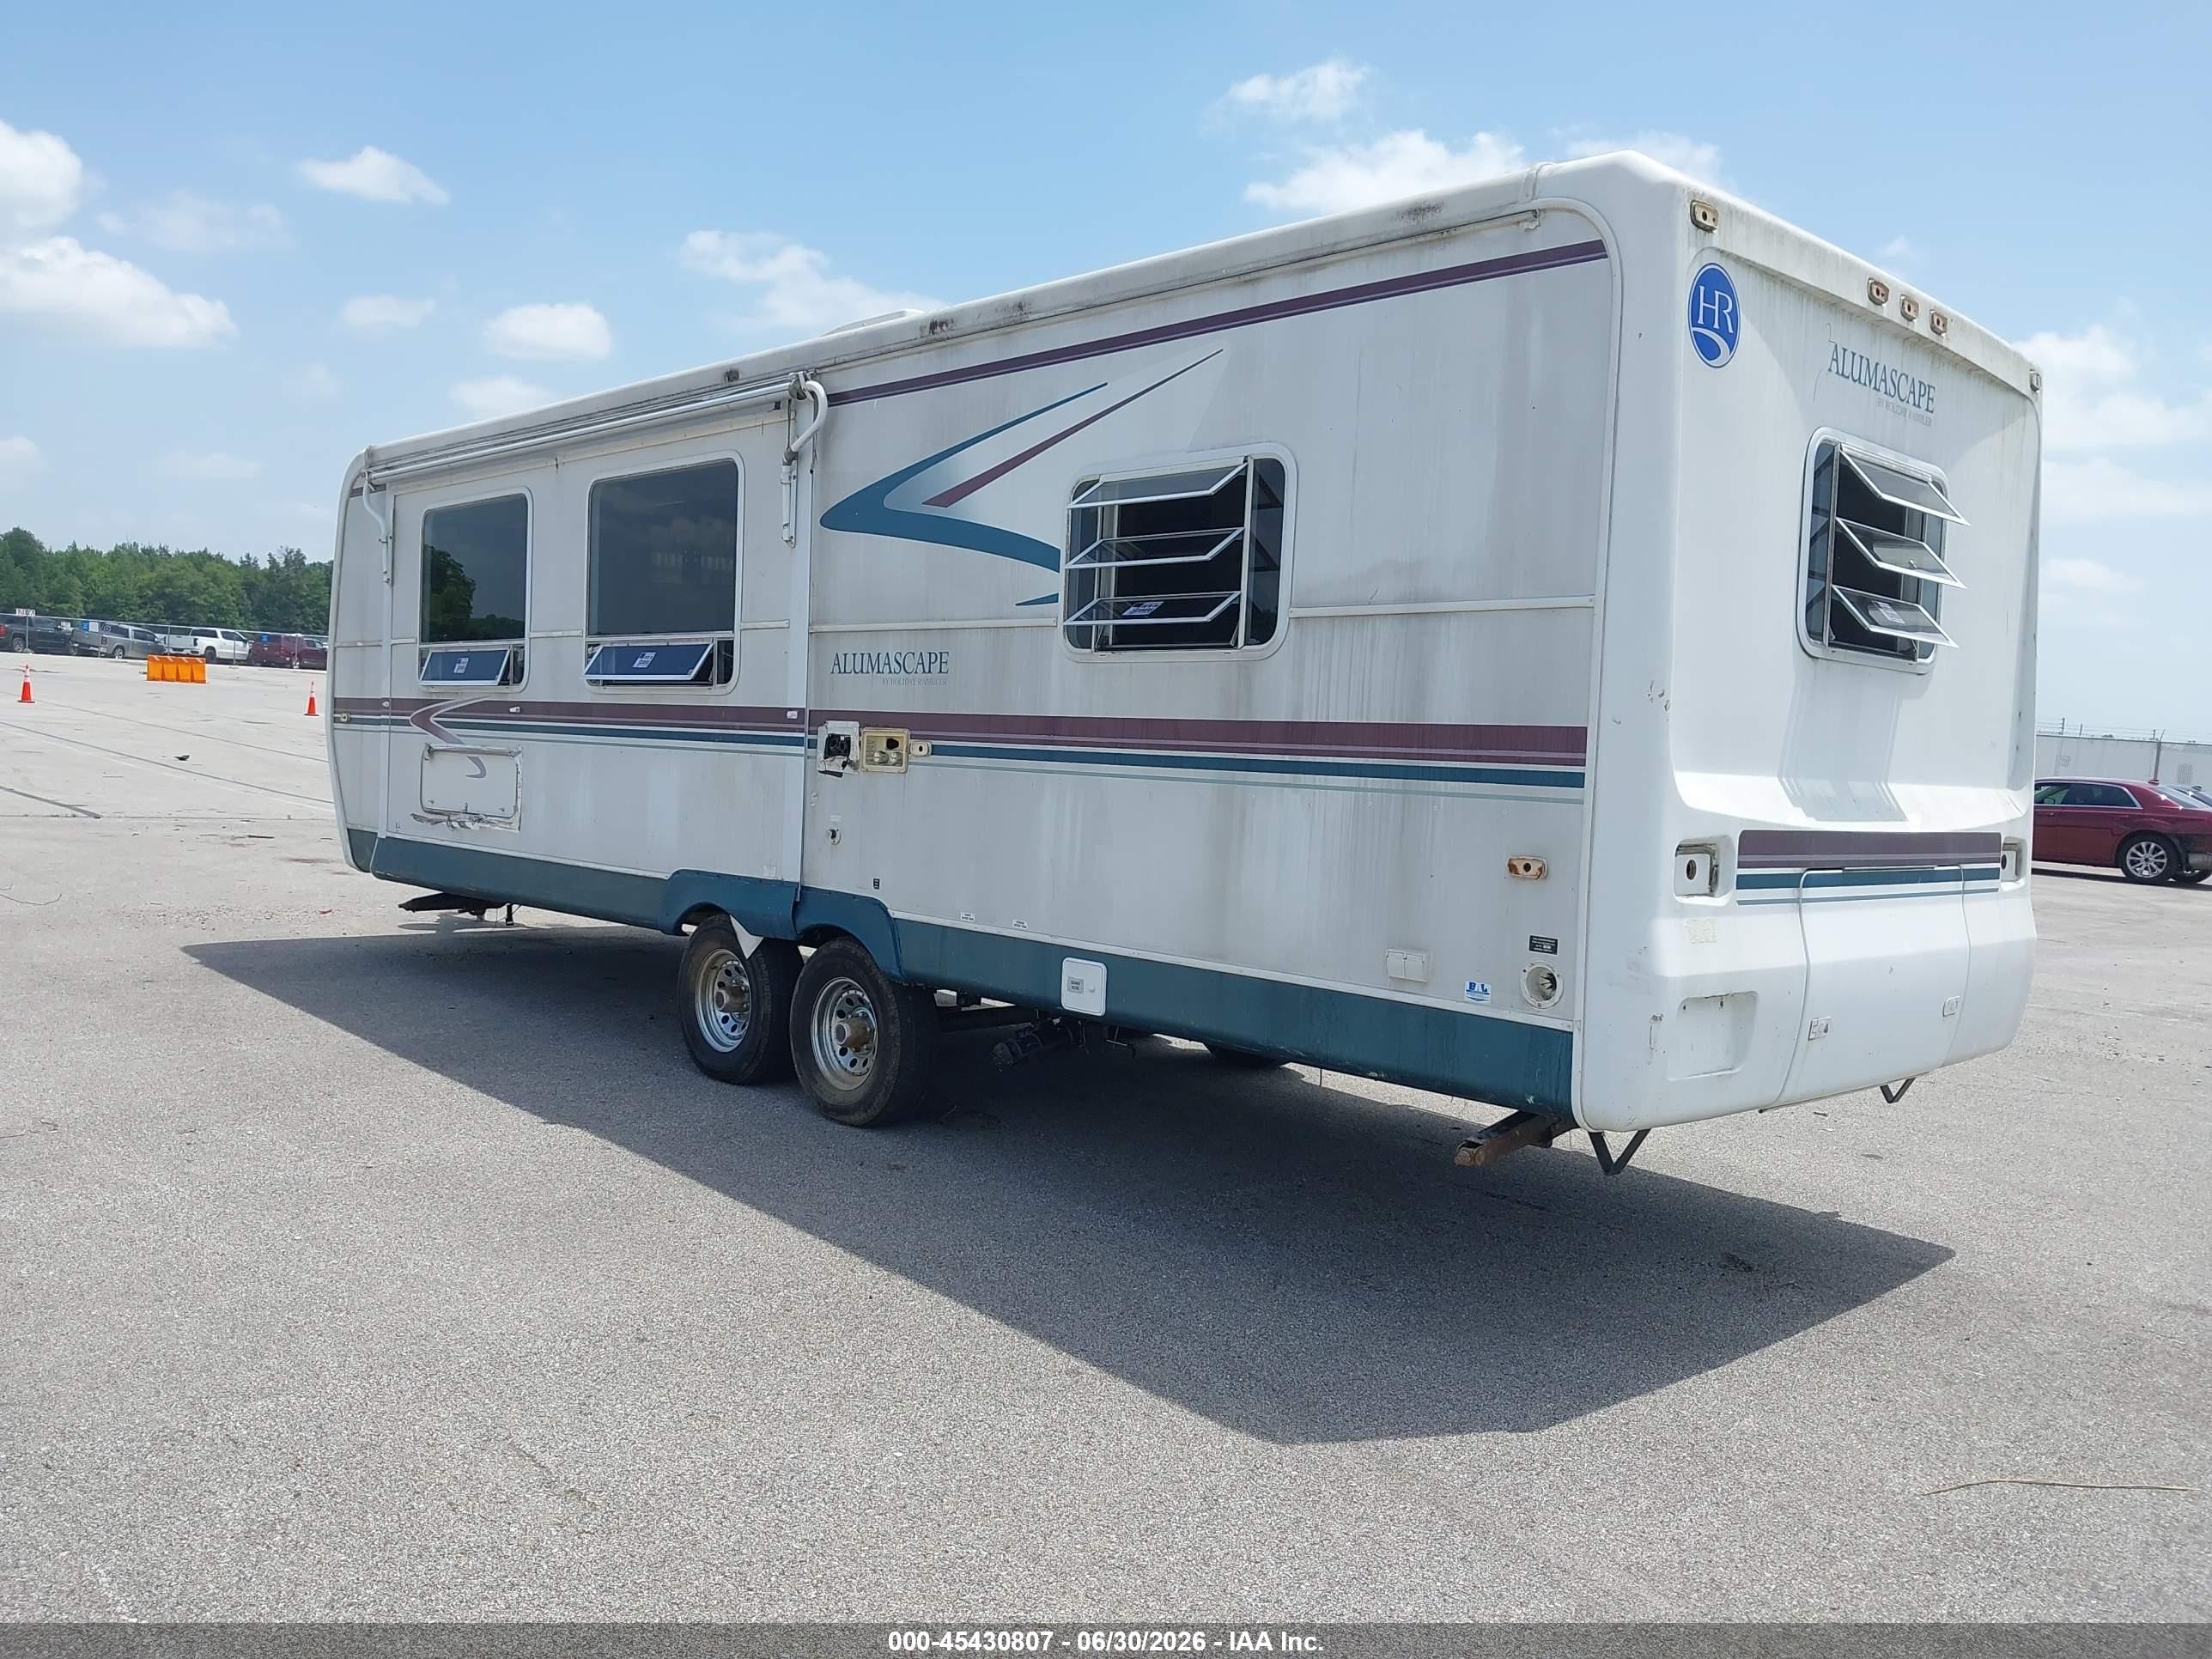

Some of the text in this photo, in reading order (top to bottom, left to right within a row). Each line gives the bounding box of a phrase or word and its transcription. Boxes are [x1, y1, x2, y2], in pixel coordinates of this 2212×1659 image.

[1697, 284, 1735, 334] HR
[1827, 343, 1936, 414] ALUMASCAPE
[830, 651, 950, 675] ALUMASCAPE
